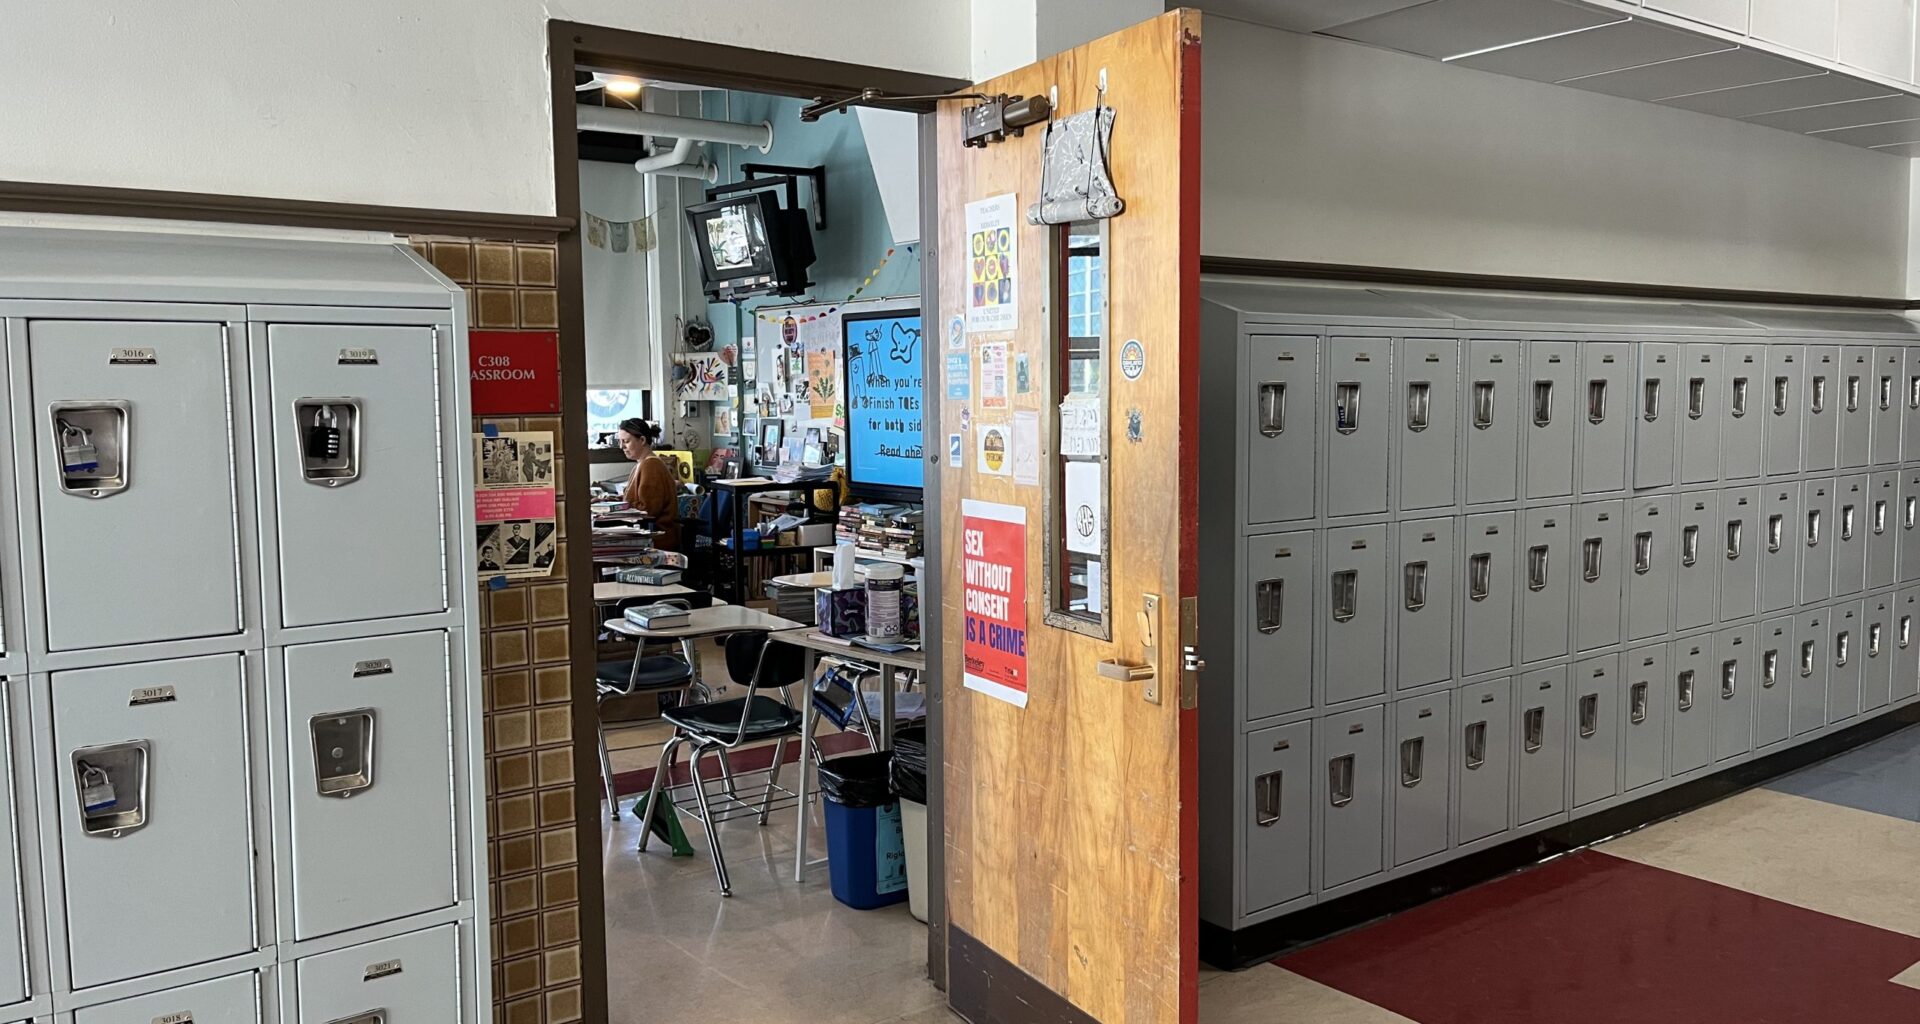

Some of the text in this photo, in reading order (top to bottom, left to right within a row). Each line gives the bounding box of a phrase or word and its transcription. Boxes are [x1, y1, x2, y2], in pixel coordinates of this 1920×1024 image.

[123, 349, 144, 358] 3016
[349, 350, 367, 358] 3019
[478, 355, 510, 367] C308
[867, 375, 922, 392] When you're
[869, 397, 895, 410] Finish
[868, 418, 881, 431] for
[880, 444, 901, 457] Read
[965, 528, 984, 557] SEX
[965, 558, 1012, 593] WITHOUT
[965, 588, 1009, 622] CONSENT
[966, 615, 1025, 658] IS A CRIME
[143, 688, 163, 697] 3017
[161, 1014, 181, 1024] 3018
